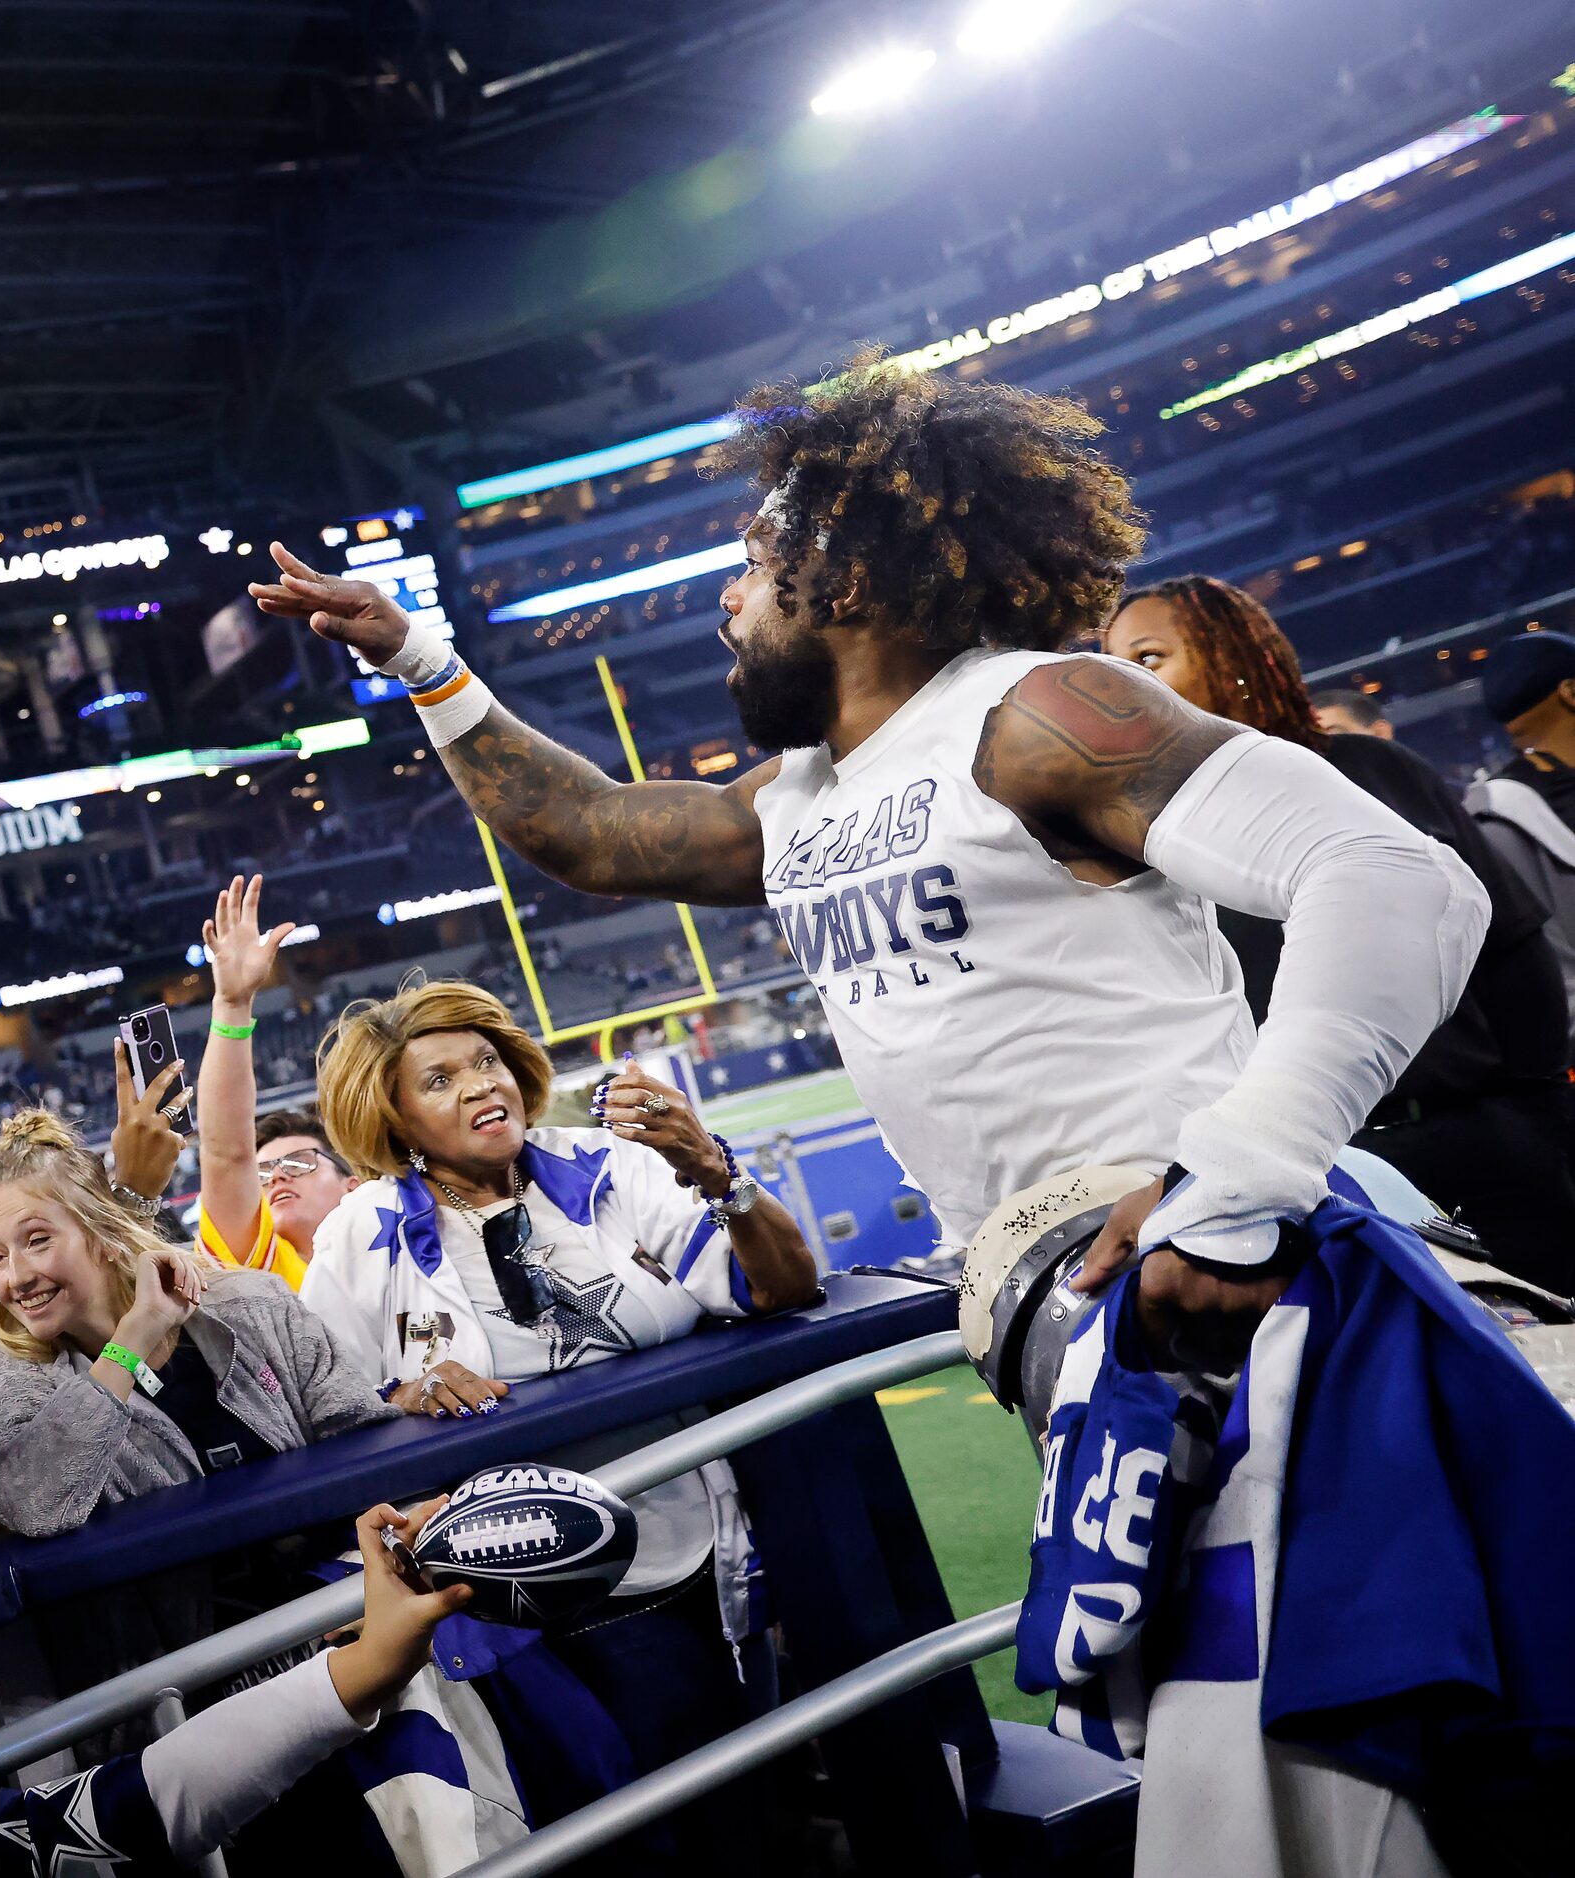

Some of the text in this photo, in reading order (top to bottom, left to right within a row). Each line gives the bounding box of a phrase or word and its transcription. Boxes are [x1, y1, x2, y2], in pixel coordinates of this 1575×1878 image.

[987, 284, 1104, 344] CASINO
[1144, 235, 1214, 282] THE
[1209, 182, 1336, 257] DALLAS
[42, 534, 170, 574] COWBOYS
[771, 862, 974, 977] WBOYS
